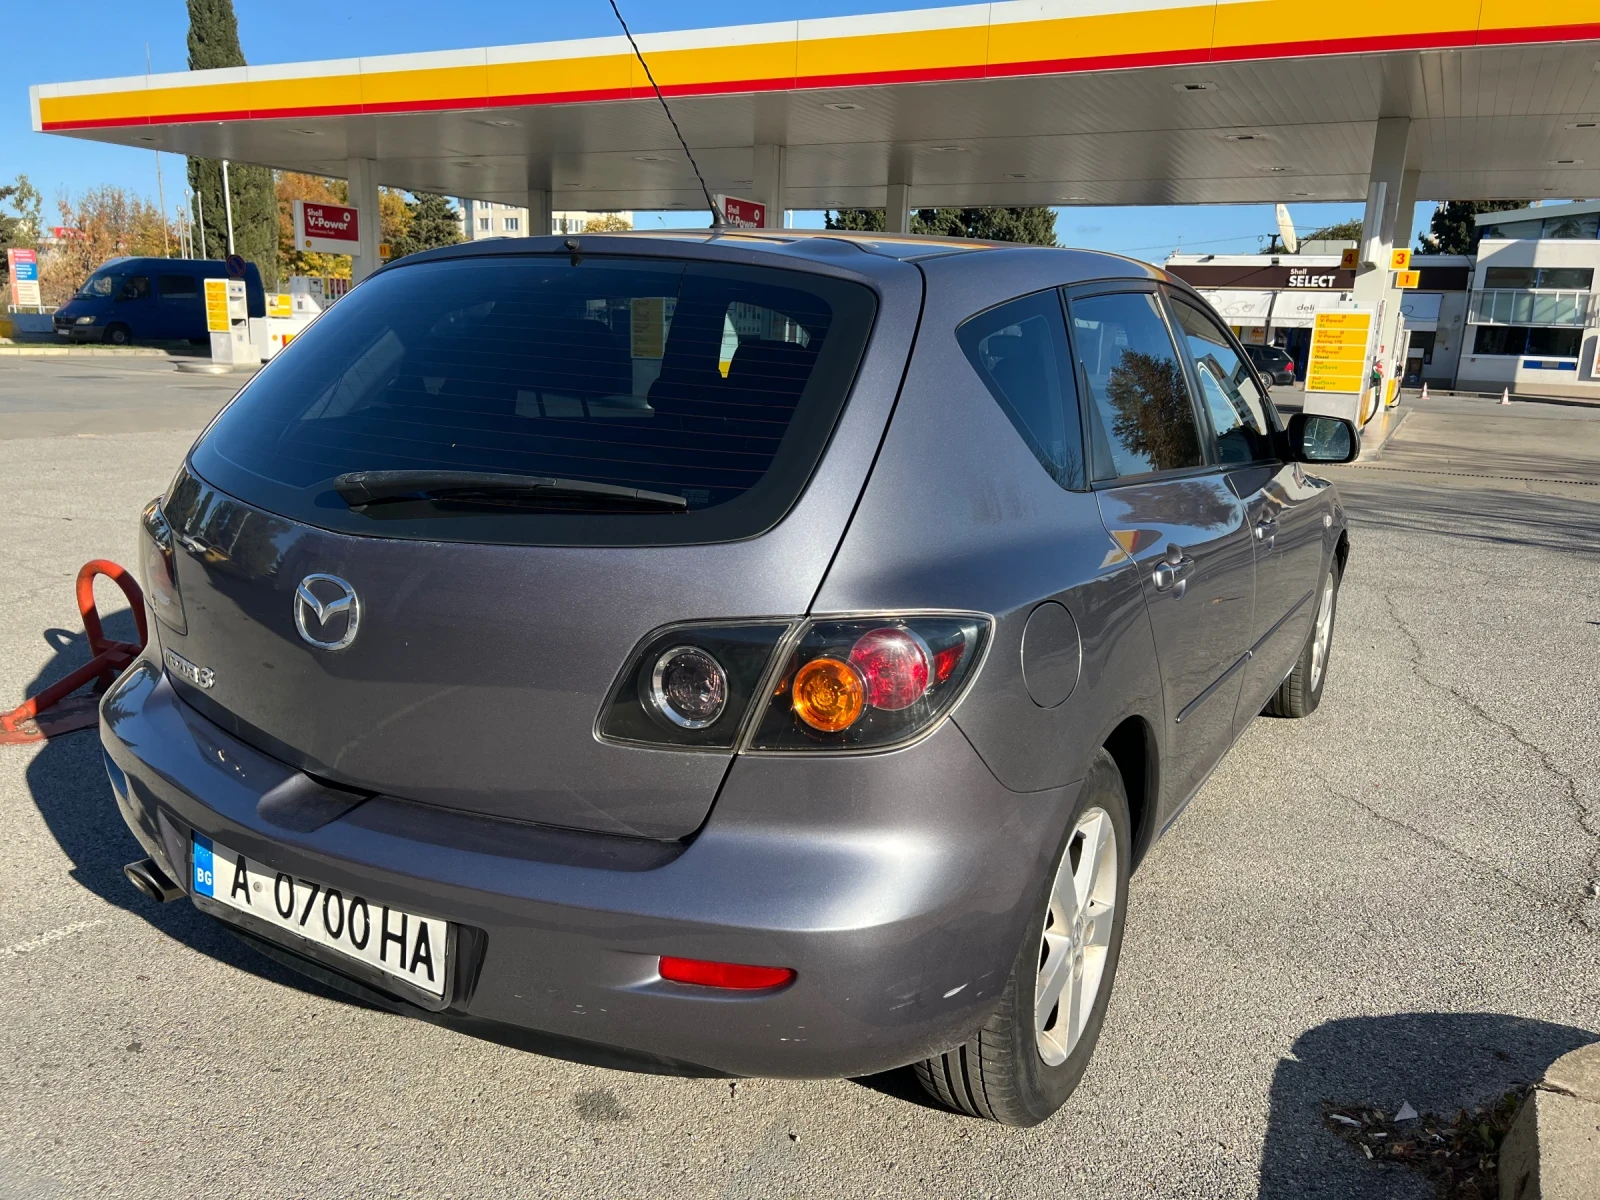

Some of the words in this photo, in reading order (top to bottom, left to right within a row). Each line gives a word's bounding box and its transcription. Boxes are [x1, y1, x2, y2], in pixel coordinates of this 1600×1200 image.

[307, 208, 323, 217] Shell
[728, 205, 740, 215] Shell
[308, 216, 348, 230] V-Power
[727, 214, 758, 228] V-Power
[1344, 253, 1354, 265] 4
[1395, 252, 1406, 265] 3
[1288, 275, 1336, 288] SELECT
[1404, 274, 1410, 284] 1
[196, 867, 213, 886] BG
[231, 853, 252, 906] A
[274, 871, 371, 951] 0700
[380, 905, 436, 983] HA
